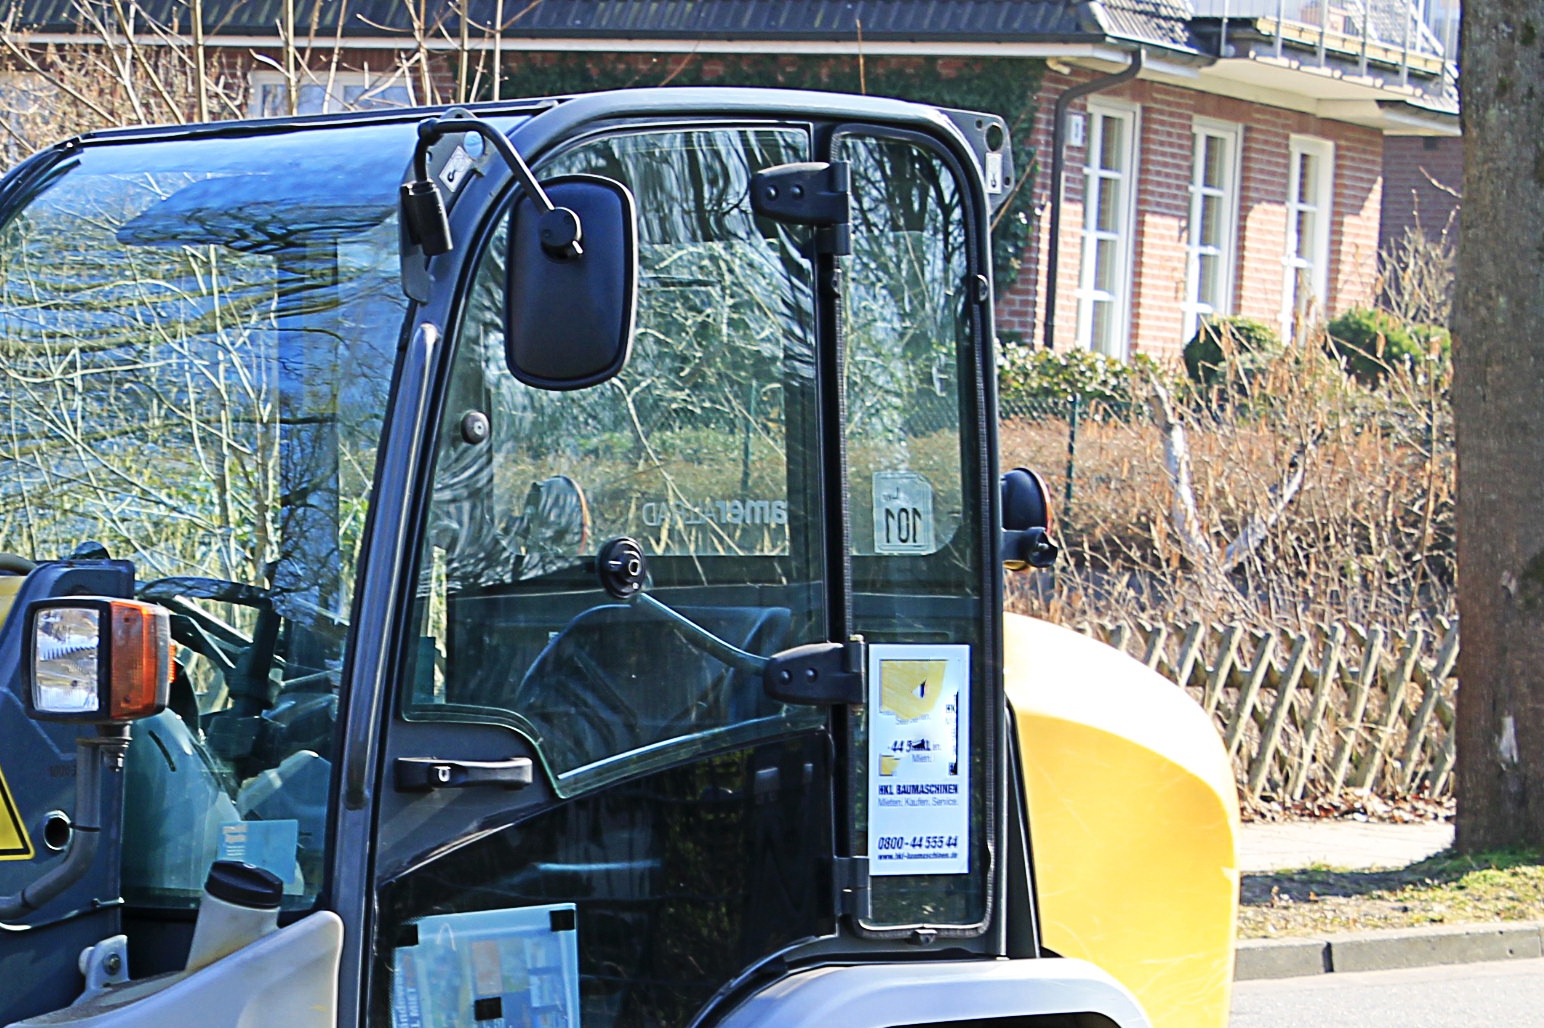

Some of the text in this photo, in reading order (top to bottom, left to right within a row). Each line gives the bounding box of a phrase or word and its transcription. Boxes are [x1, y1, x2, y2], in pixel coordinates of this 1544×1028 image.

[878, 784, 958, 795] HKL BAUMASCHINEN
[925, 836, 945, 849] 555
[946, 835, 958, 848] 44
